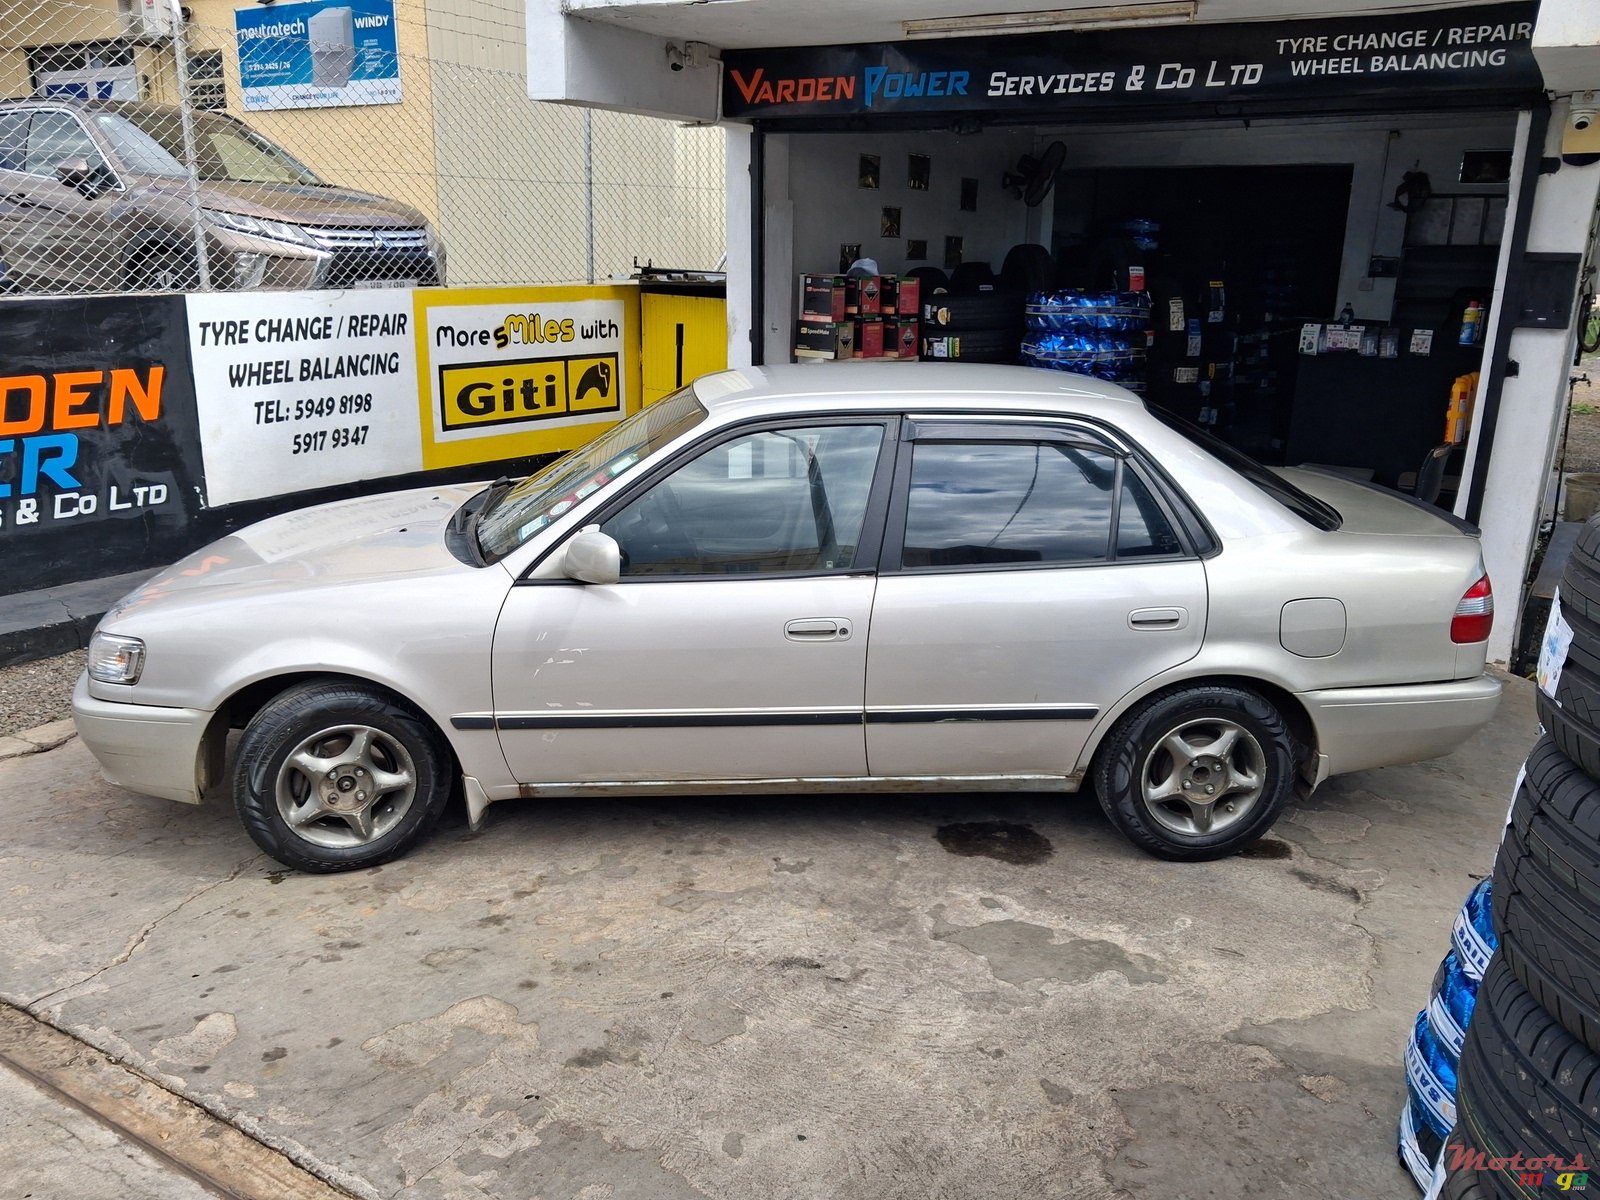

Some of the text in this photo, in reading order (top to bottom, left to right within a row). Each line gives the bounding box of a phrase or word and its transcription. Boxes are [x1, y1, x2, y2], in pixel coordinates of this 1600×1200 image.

[355, 15, 389, 29] WINDY
[1276, 22, 1532, 55] TYRE CHANGE / REPAIR
[1291, 49, 1506, 76] WHEEL BALANCING
[730, 68, 856, 104] VARDEN
[864, 66, 970, 107] POWER
[987, 71, 1115, 96] SERVICES
[1125, 65, 1145, 91] &
[199, 313, 408, 346] TYRE CHANGE / REPAIR
[436, 325, 491, 347] More
[580, 319, 619, 340] with
[228, 352, 399, 388] WHEEL BALANCING
[254, 393, 373, 425] TEL: 5949 8198
[456, 374, 557, 417] Giti
[292, 425, 369, 455] 5917 9347
[15, 497, 40, 525] &
